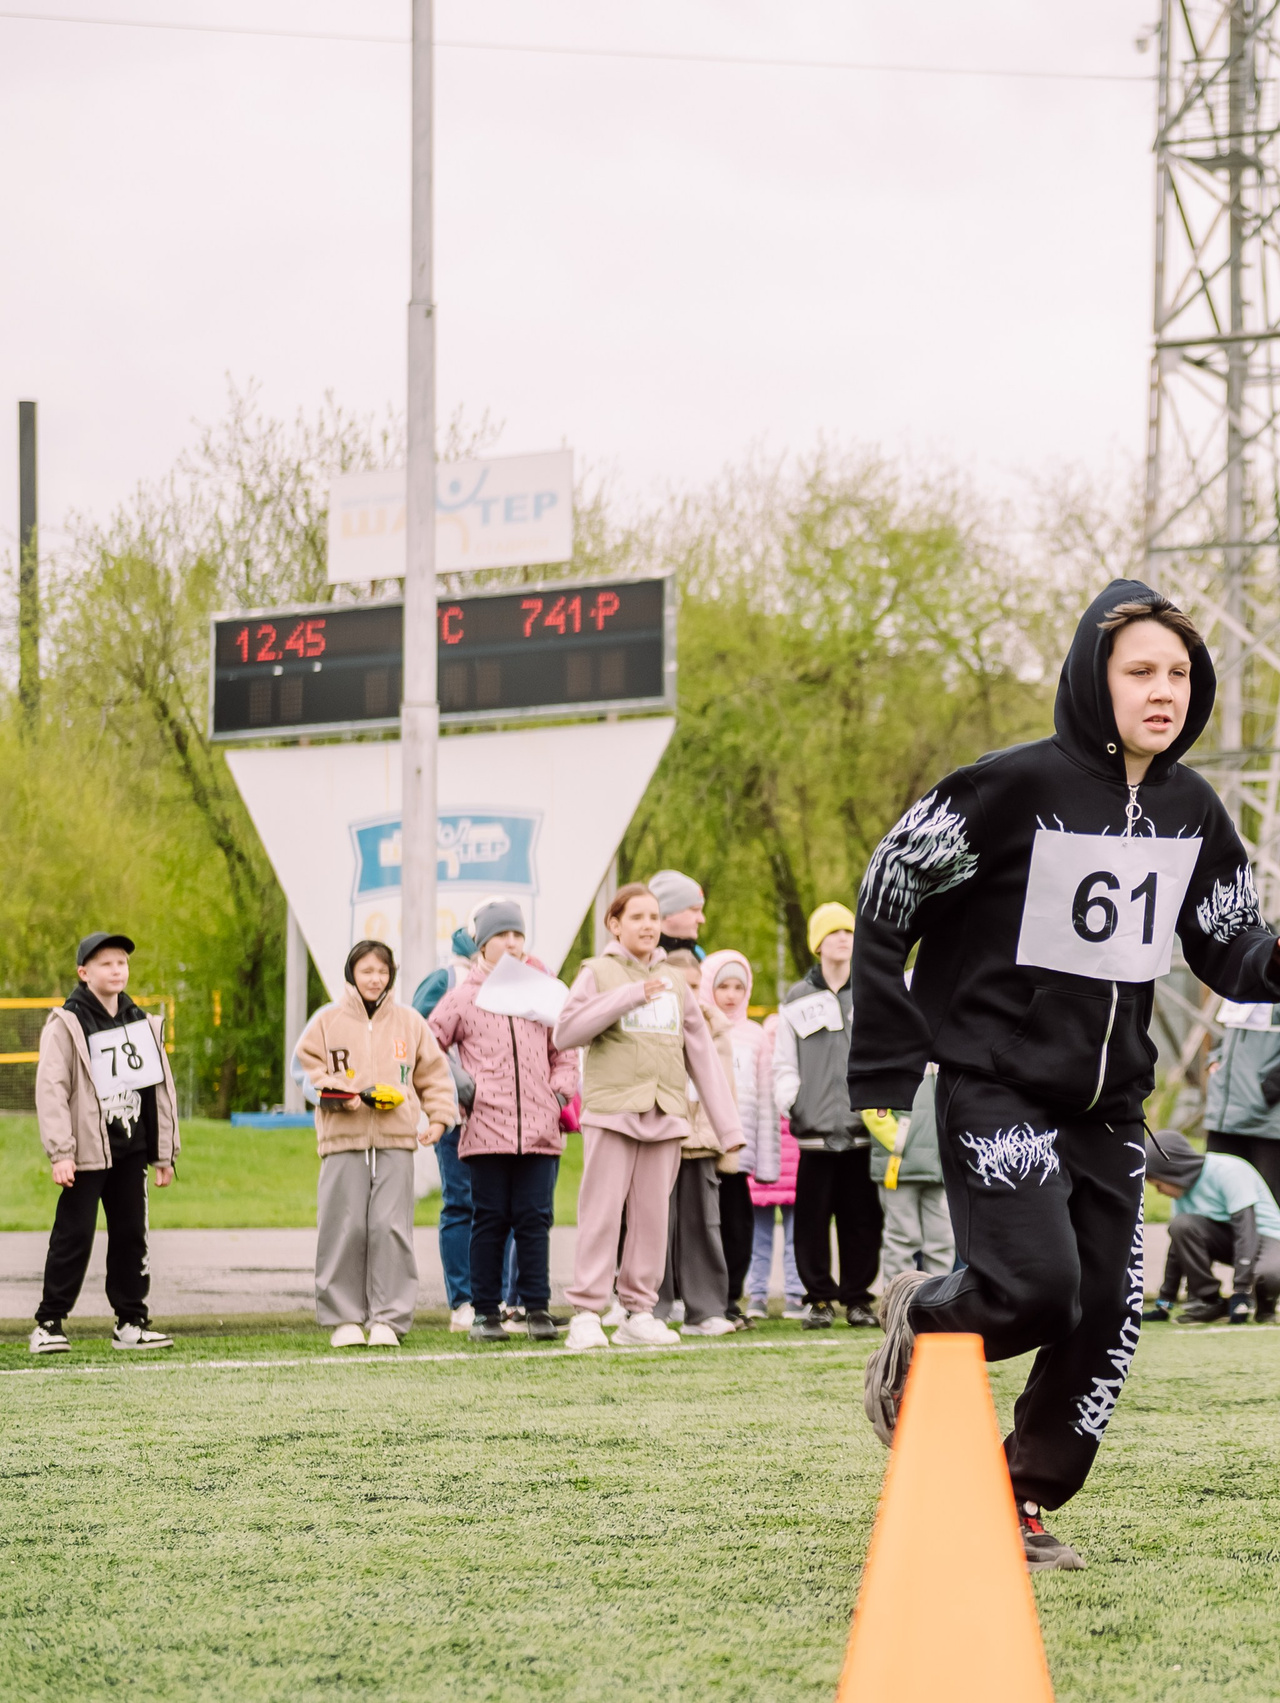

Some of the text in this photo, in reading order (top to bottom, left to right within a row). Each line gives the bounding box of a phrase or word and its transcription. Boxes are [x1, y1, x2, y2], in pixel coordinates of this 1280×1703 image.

[1071, 871, 1158, 945] 61
[100, 1042, 144, 1077] 78
[329, 1049, 350, 1073] R
[394, 1039, 407, 1059] B
